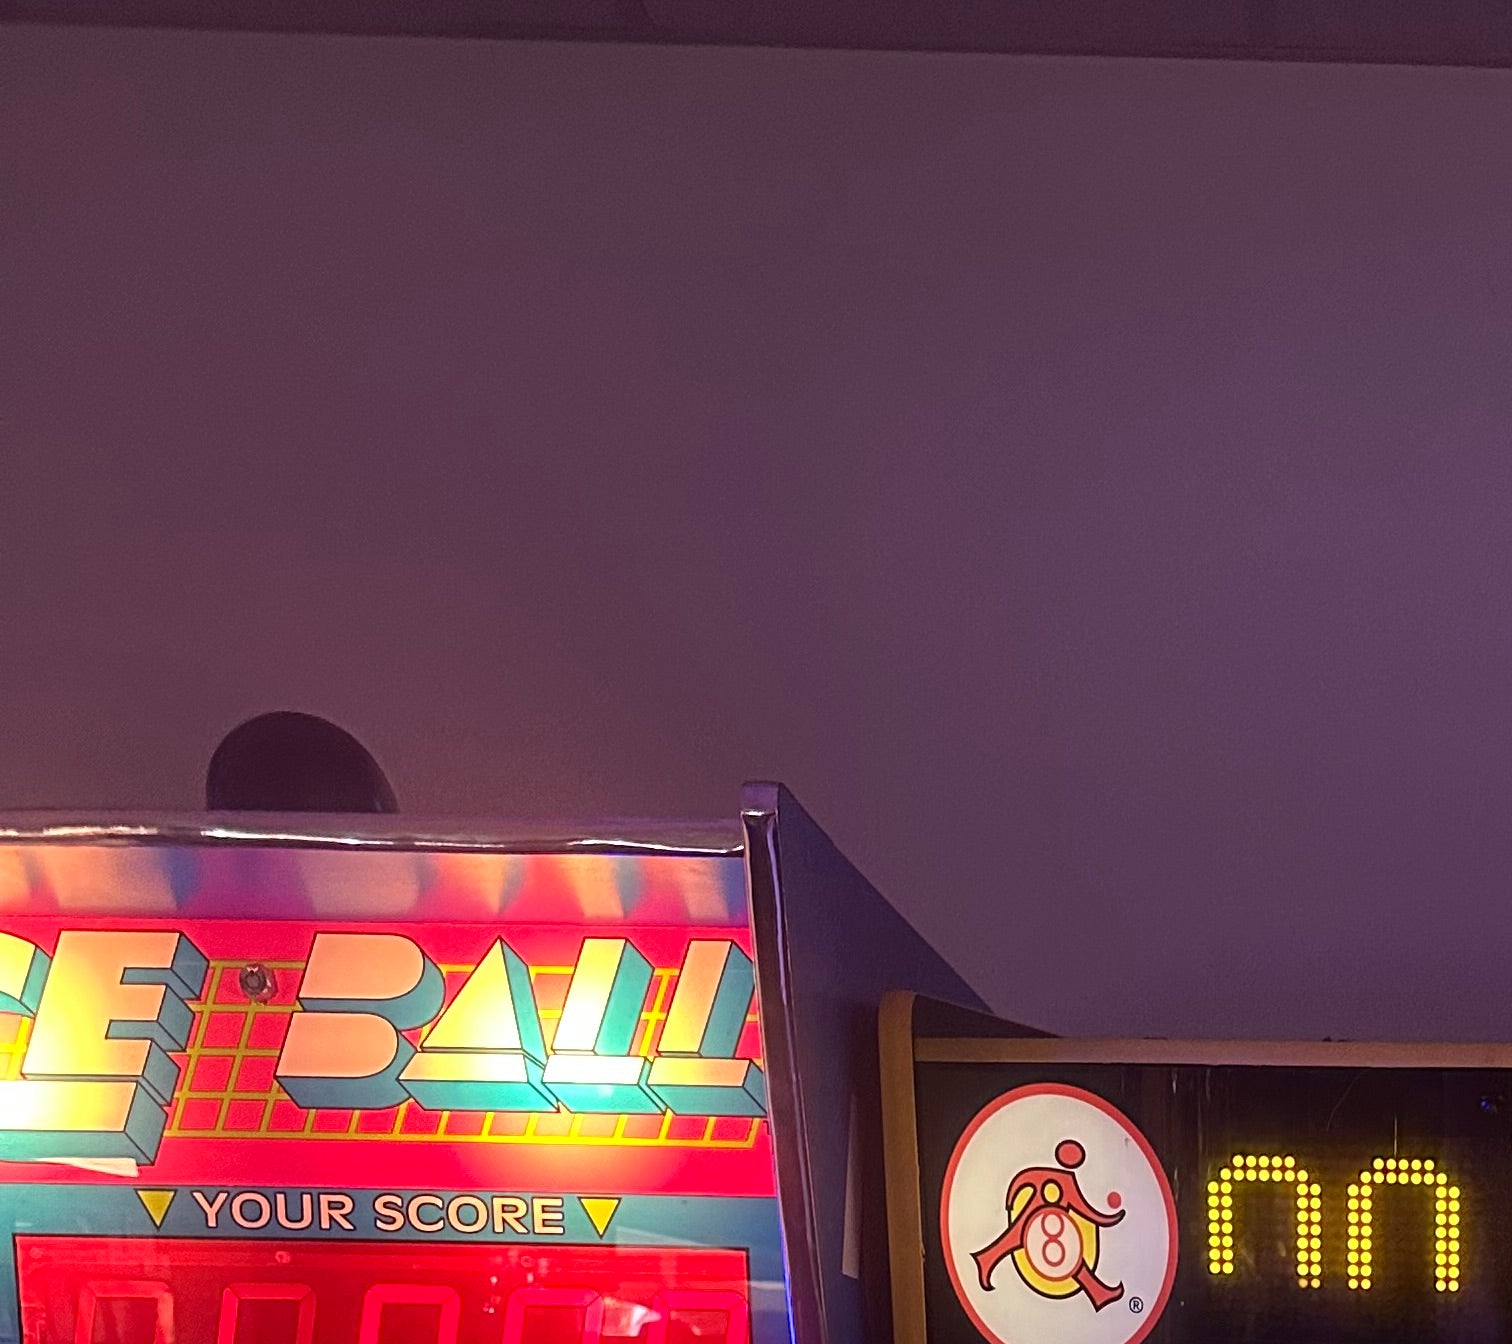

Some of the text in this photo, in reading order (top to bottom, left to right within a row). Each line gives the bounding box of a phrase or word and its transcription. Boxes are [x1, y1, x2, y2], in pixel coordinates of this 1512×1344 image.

[0, 928, 770, 1166] E BALL
[192, 1190, 566, 1236] YOUR SCORE
